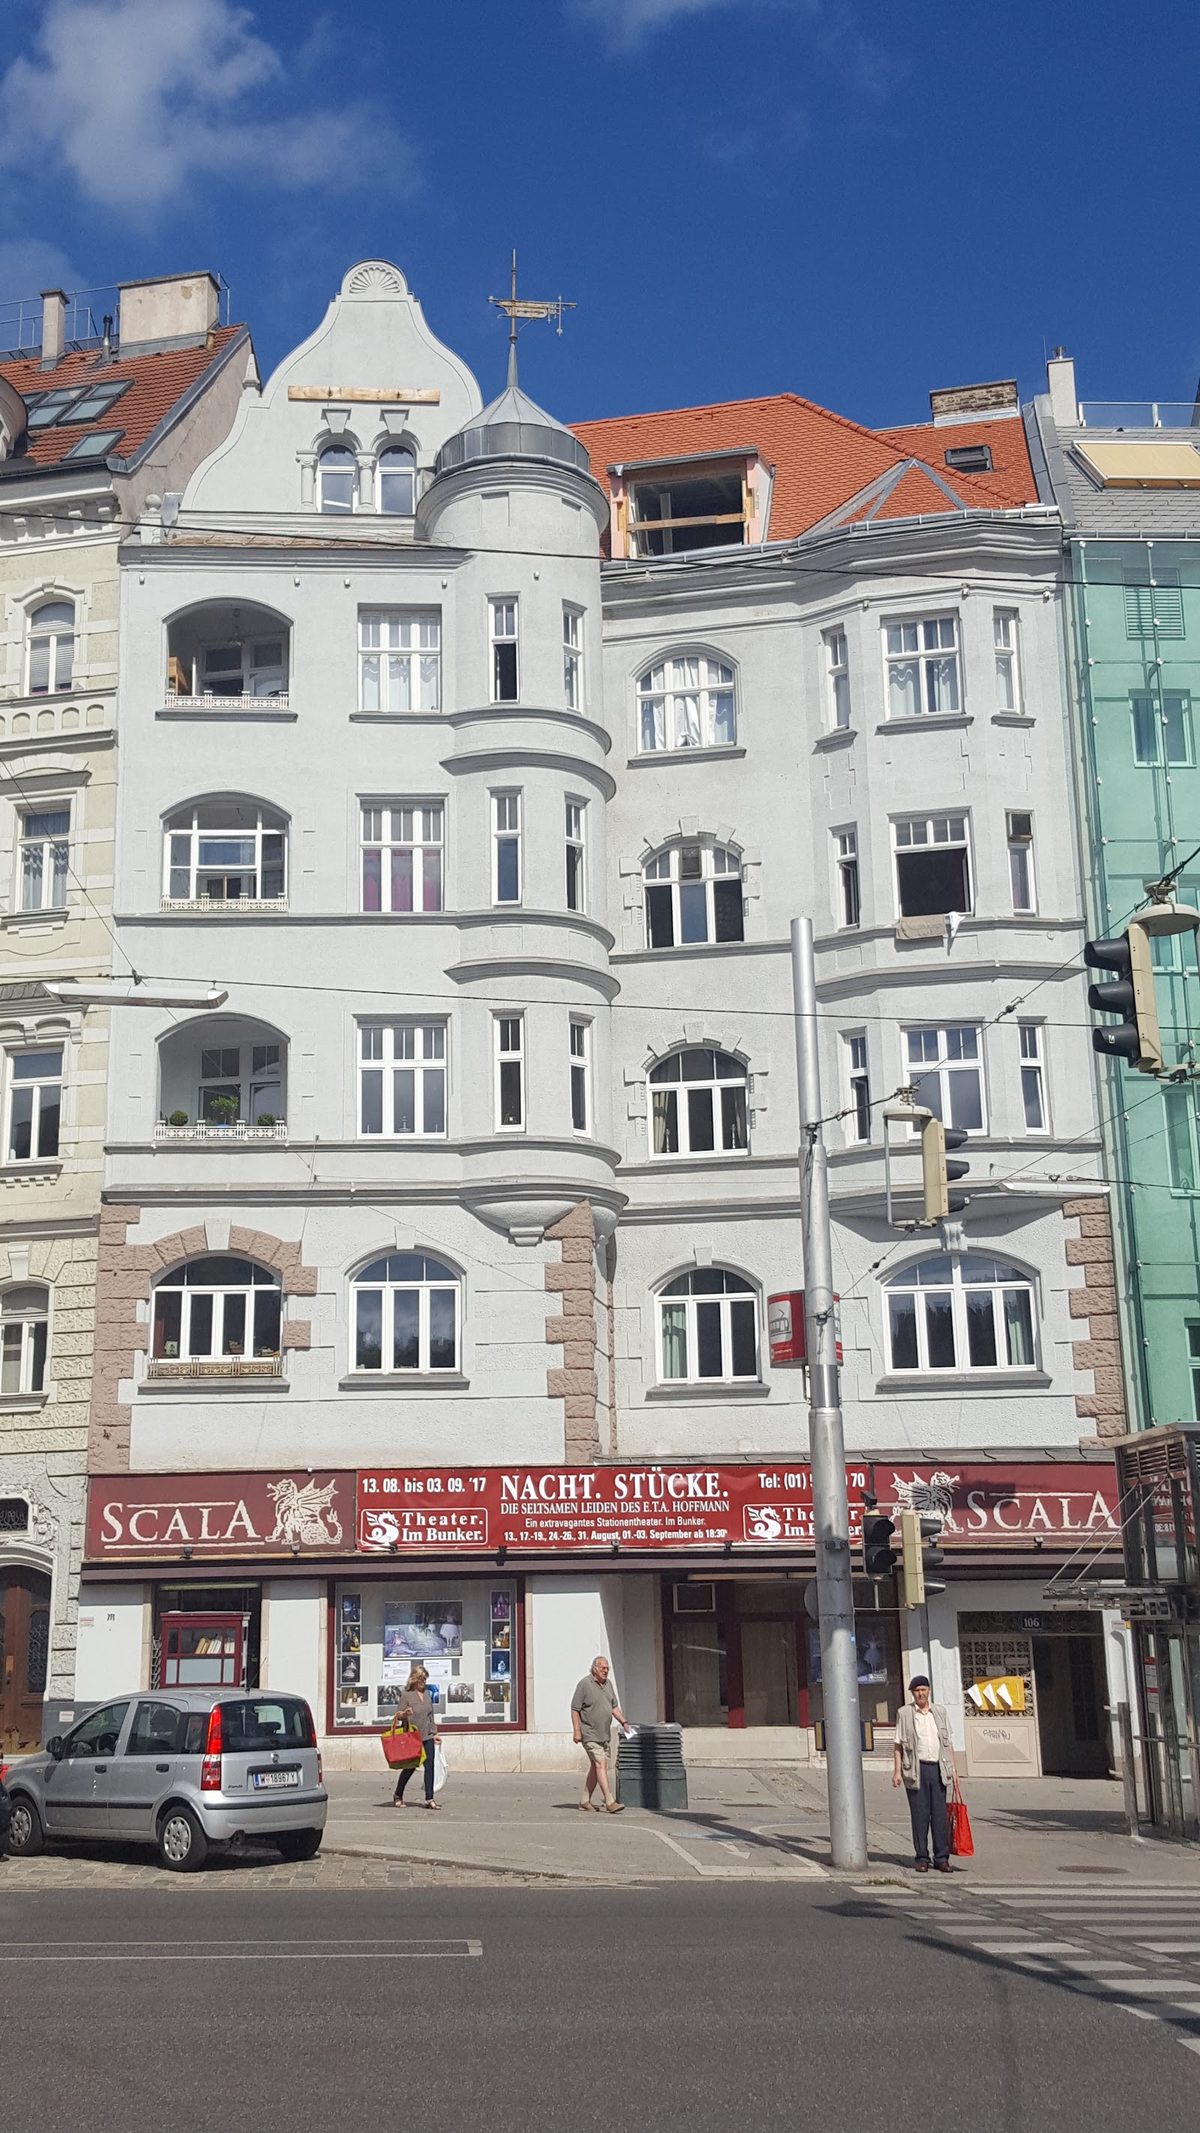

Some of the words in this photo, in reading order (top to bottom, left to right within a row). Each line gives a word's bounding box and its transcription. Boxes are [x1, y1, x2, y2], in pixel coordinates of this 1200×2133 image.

[362, 1478, 380, 1493] 13.
[382, 1478, 401, 1493] 08.
[404, 1477, 424, 1493] bis
[426, 1477, 445, 1493] 03.
[447, 1477, 466, 1492] 09.
[500, 1473, 601, 1500] NACHT.
[614, 1466, 729, 1499] STÜCKE.
[757, 1472, 781, 1489] Tel:
[784, 1472, 807, 1490] (01)
[850, 1472, 865, 1487] 70
[500, 1502, 519, 1515] DIE
[521, 1502, 578, 1514] SELTSAMEN
[581, 1501, 618, 1514] LEIDEN
[621, 1501, 641, 1513] DES
[643, 1501, 670, 1513] E.T.A.
[672, 1500, 730, 1512] HOFFMANN
[967, 1490, 1122, 1530] SCALA
[100, 1499, 261, 1543] SCALA
[401, 1512, 484, 1526] Theater.
[525, 1518, 538, 1528] Ein
[539, 1518, 595, 1530] extravagantes
[596, 1517, 664, 1527] Stationentheater.
[665, 1516, 676, 1526] Im
[677, 1516, 706, 1526] Bunker.
[401, 1527, 423, 1542] Im
[426, 1527, 484, 1542] Bunker.
[504, 1531, 518, 1542] 13.,
[577, 1530, 589, 1541] 31.
[591, 1530, 621, 1542] August,
[622, 1530, 648, 1540] 01.-03.
[649, 1529, 692, 1541] September
[693, 1529, 704, 1539] ab
[783, 1522, 805, 1537] Im
[1023, 1616, 1040, 1628] 106
[259, 1774, 266, 1784] W
[290, 1772, 295, 1782] Y
